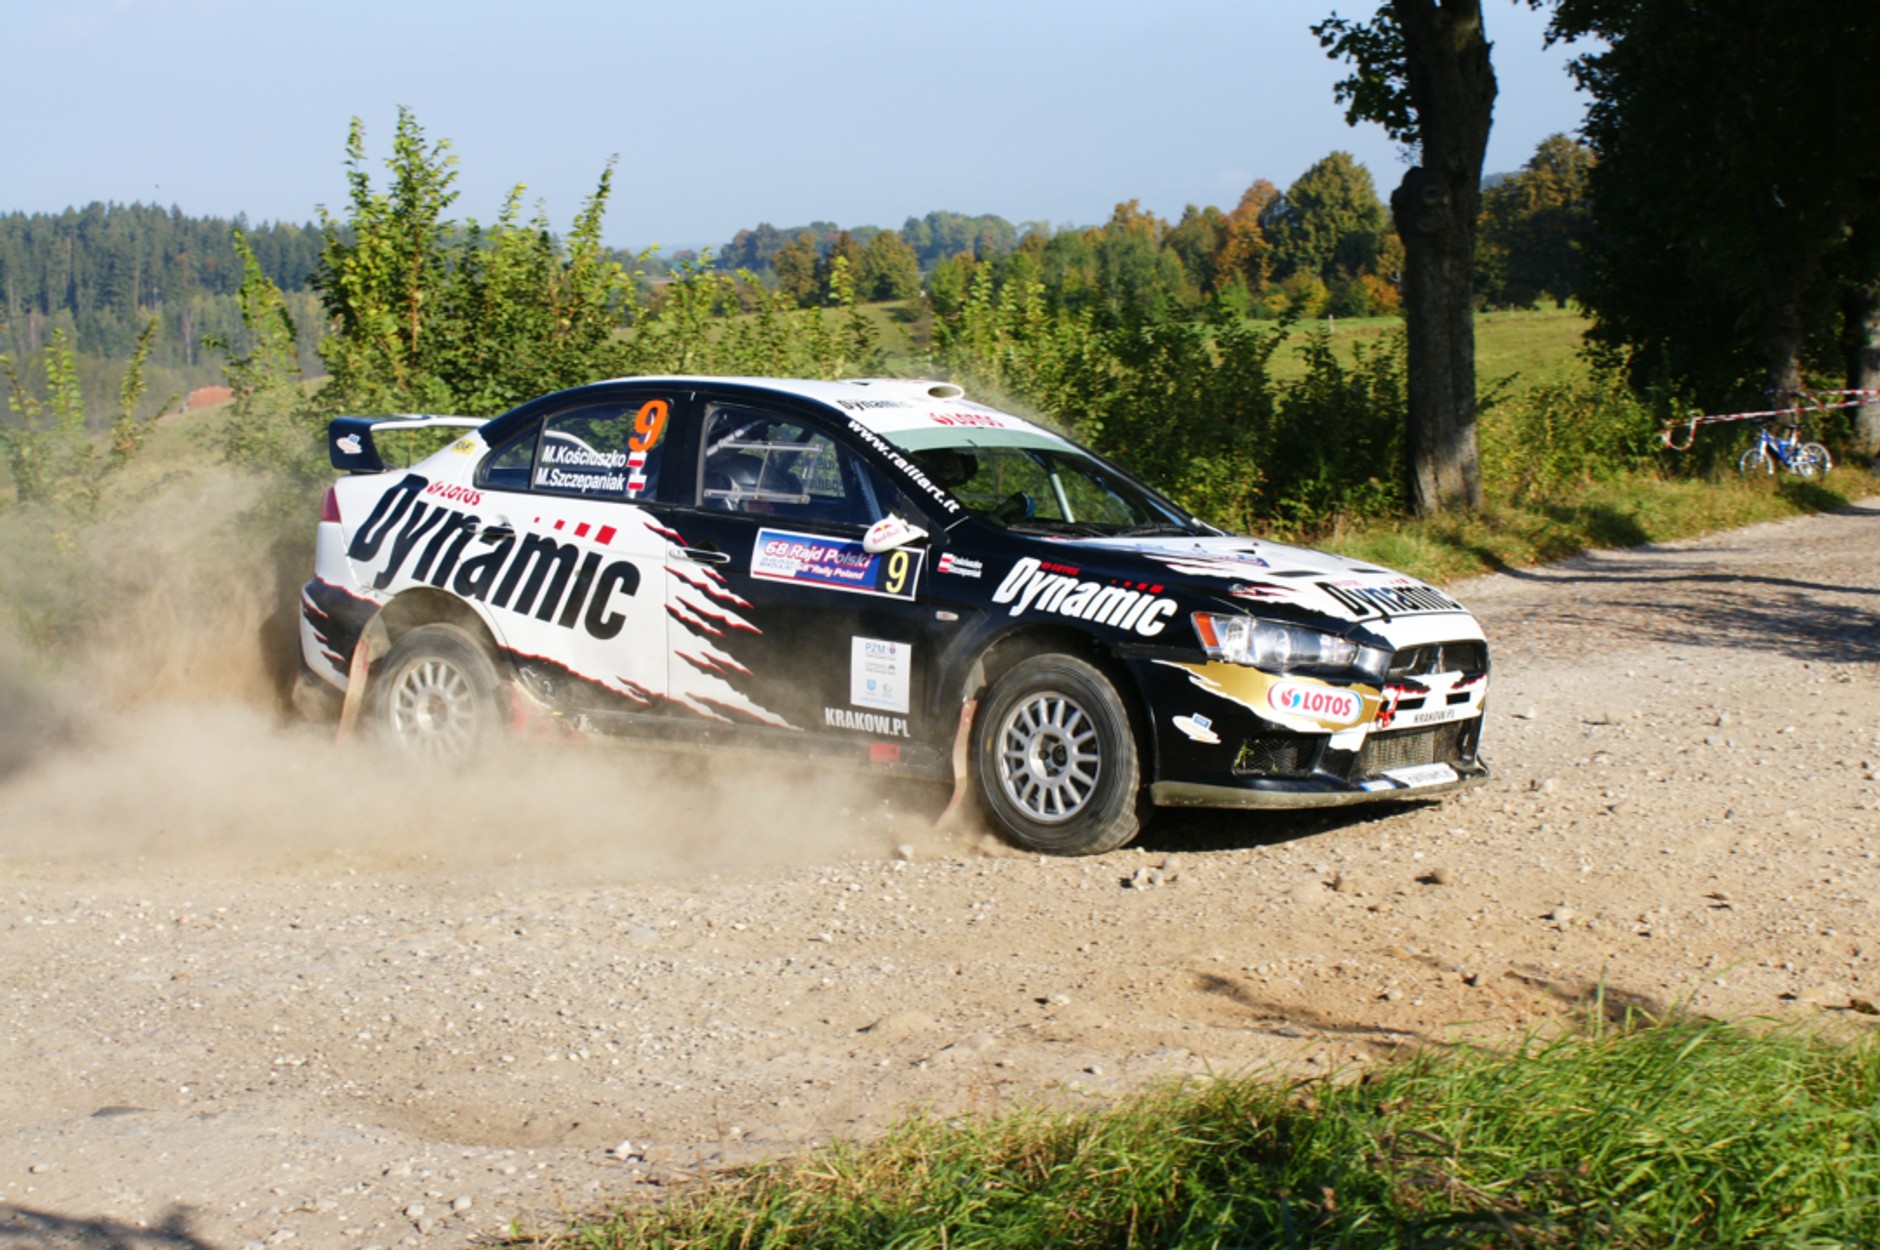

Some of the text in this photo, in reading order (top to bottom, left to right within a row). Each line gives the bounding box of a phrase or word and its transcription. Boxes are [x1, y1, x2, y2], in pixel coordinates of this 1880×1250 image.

[628, 399, 668, 452] 9
[534, 466, 626, 494] M.Szczepaniak
[848, 420, 961, 514] www.ralliart.it
[440, 483, 485, 506] LOTOS
[346, 473, 641, 640] Dynamic
[764, 540, 788, 558] 68
[788, 543, 824, 564] Rajd
[824, 547, 875, 570] Polski
[885, 550, 910, 594] 9
[991, 556, 1179, 637] Dynamic
[824, 706, 912, 738] KRAKOW.PL
[1302, 690, 1353, 718] LOTOS
